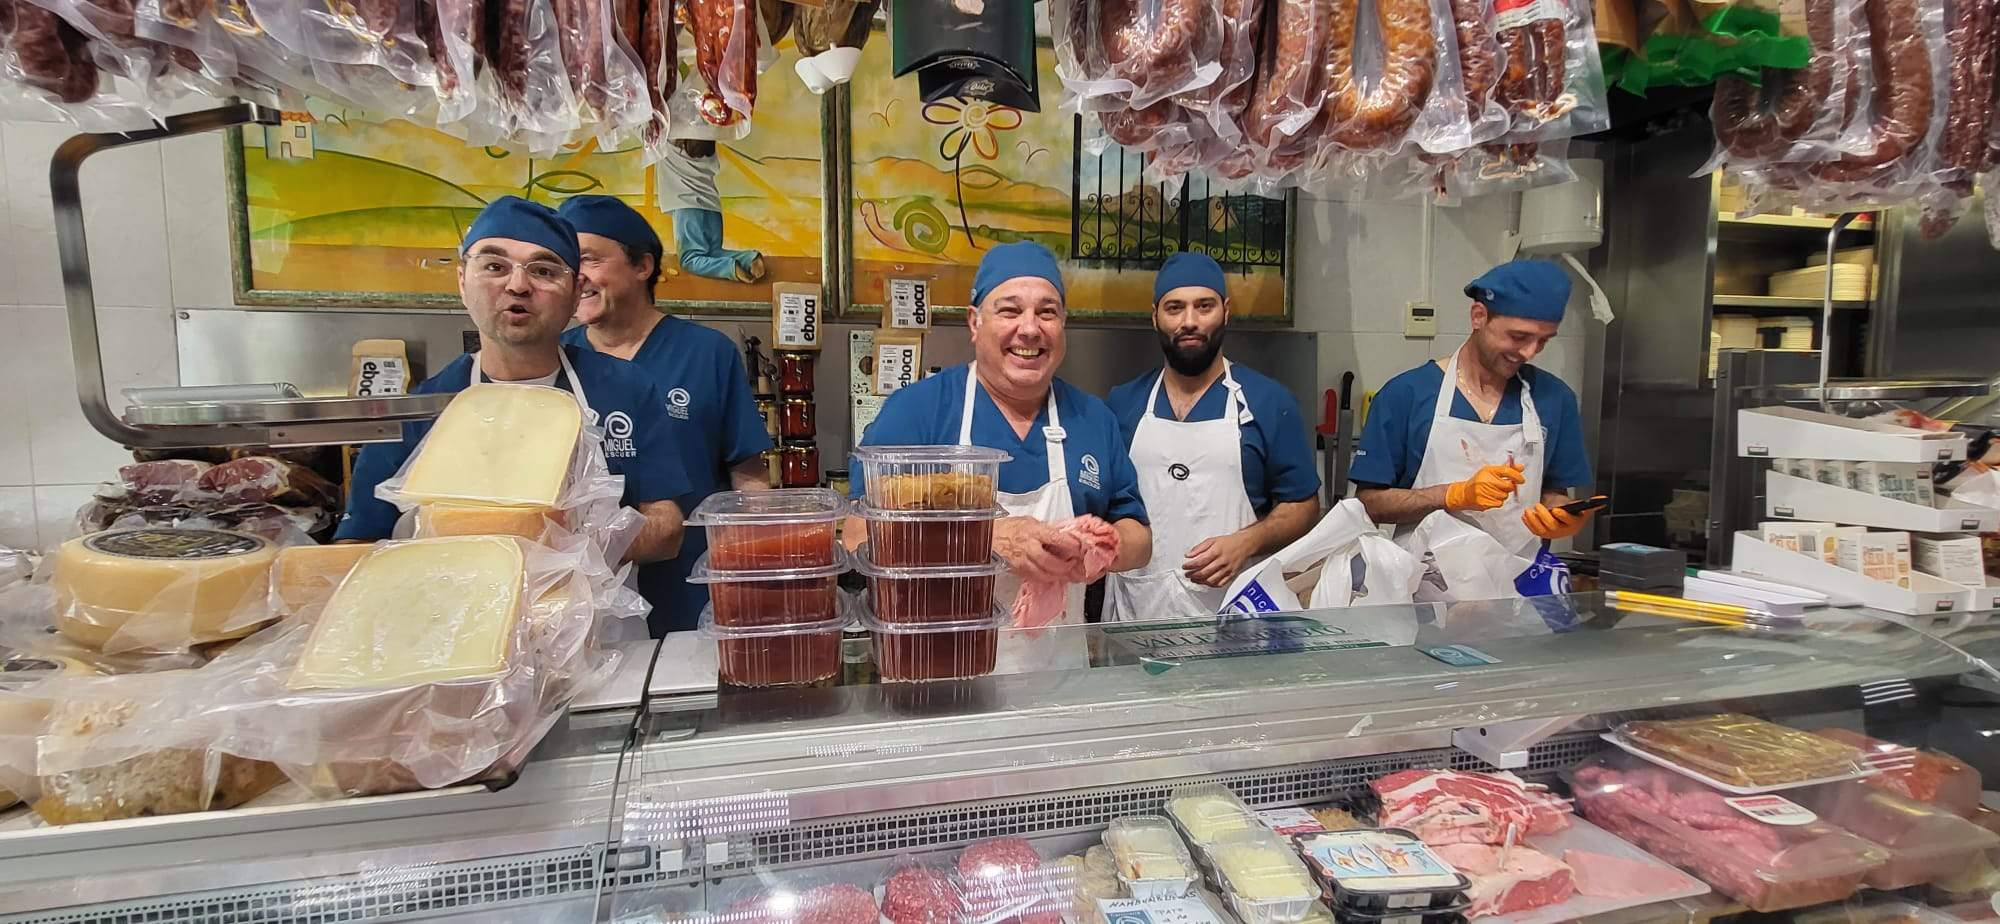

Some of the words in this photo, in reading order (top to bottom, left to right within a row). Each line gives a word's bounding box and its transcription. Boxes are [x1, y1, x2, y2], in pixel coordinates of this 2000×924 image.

[800, 298, 816, 342] eboca
[912, 284, 926, 325] eboca
[358, 361, 380, 396] eboc
[604, 439, 637, 452] MIGUEL
[1247, 587, 1273, 612] nic
